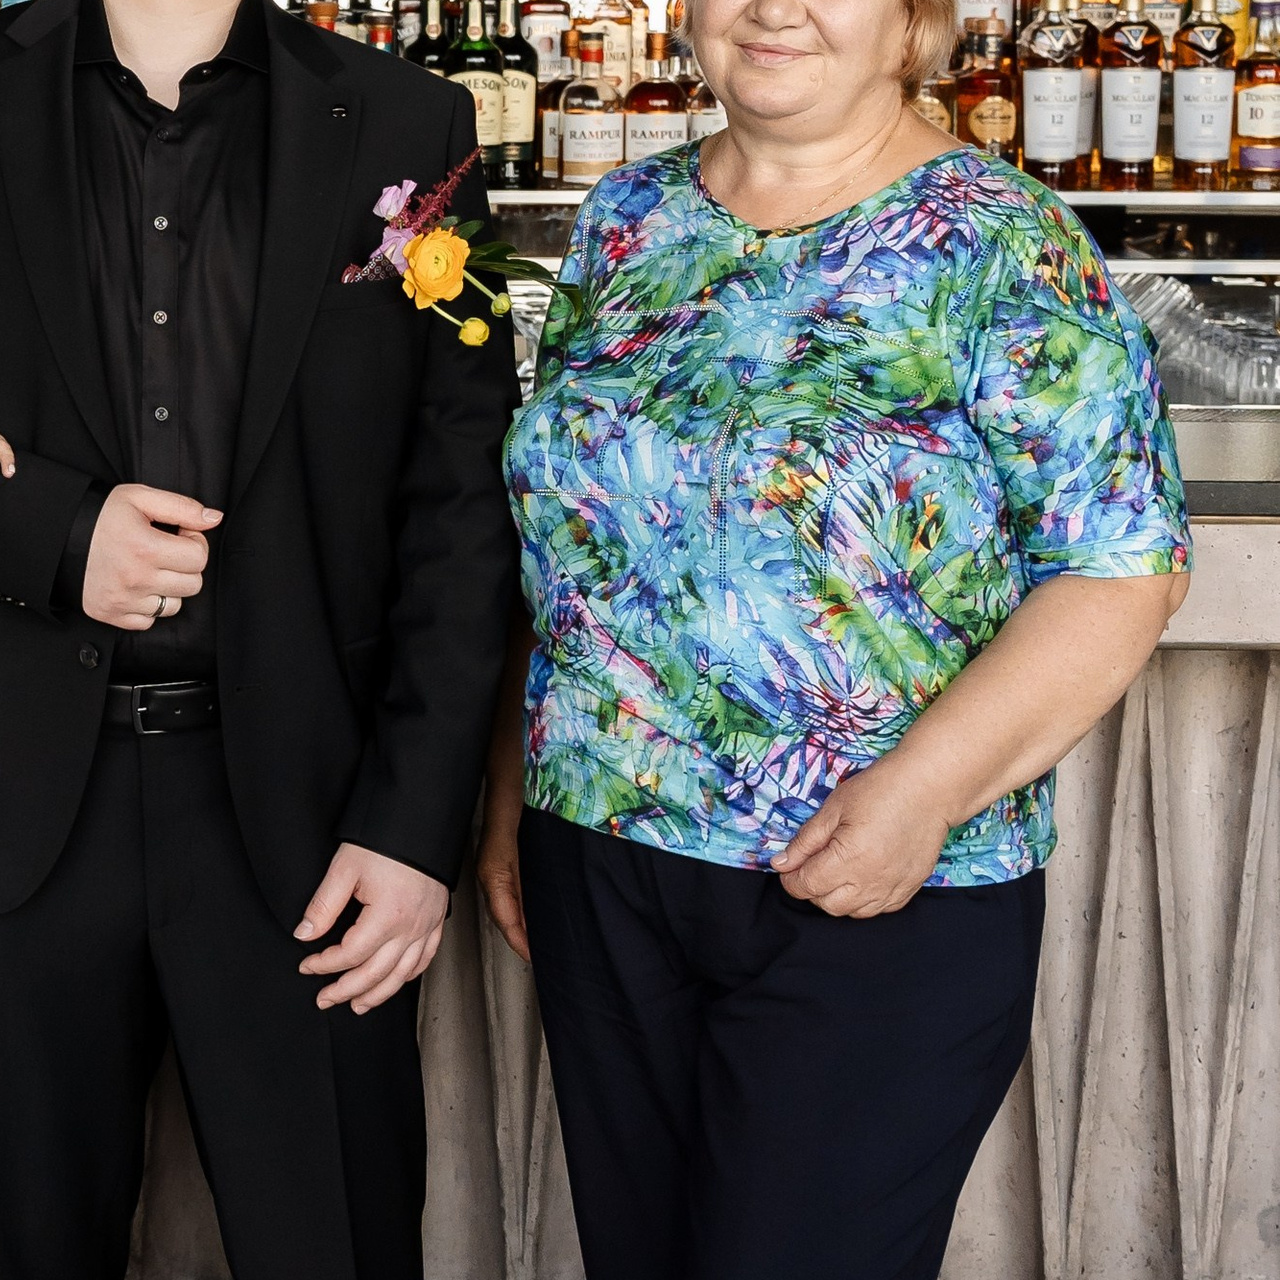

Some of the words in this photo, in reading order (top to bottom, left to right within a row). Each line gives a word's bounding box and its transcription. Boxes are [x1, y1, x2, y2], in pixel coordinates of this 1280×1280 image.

[461, 77, 501, 92] MESON
[1248, 106, 1264, 120] 10
[569, 128, 621, 141] RAMPUR
[630, 128, 685, 141] RAMPUR
